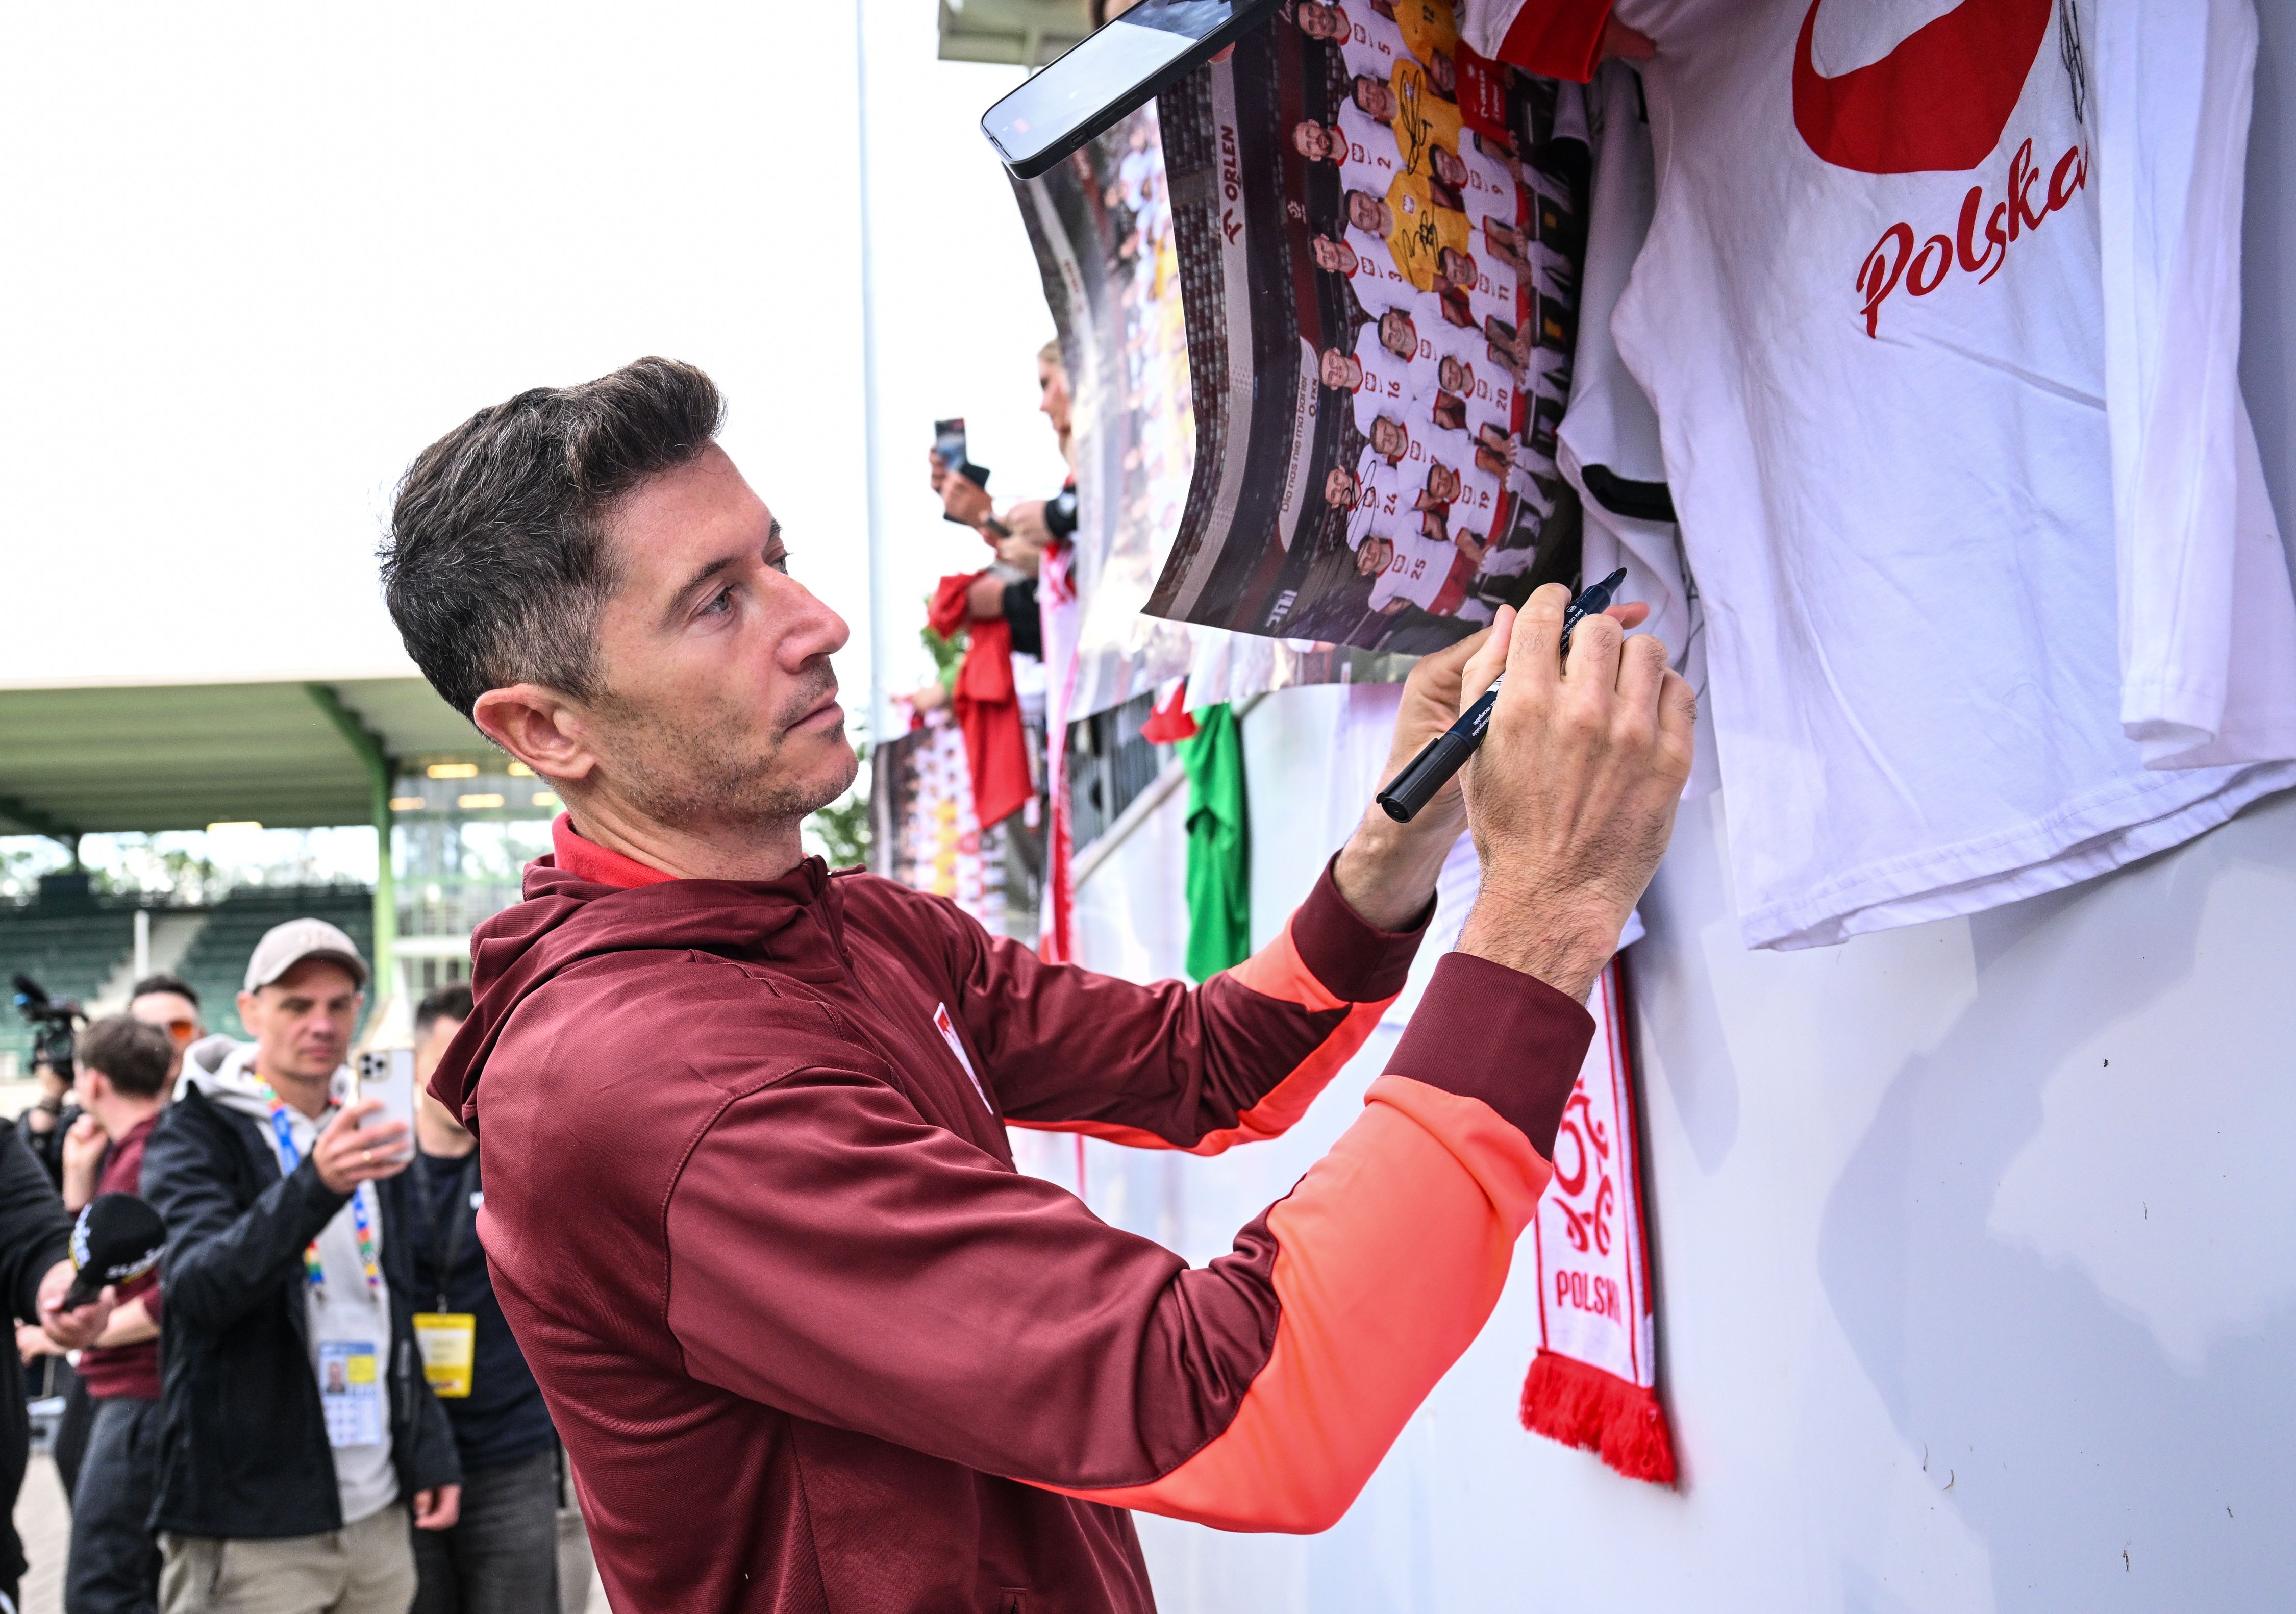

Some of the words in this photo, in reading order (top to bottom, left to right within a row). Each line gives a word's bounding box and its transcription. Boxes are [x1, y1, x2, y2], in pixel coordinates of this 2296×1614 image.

[1378, 41, 1391, 55] 5
[1220, 125, 1238, 202] ORLEN
[1378, 156, 1391, 169] 2
[1856, 137, 2088, 339] Polska
[1388, 270, 1402, 282] 3
[1499, 285, 1509, 300] 11
[1296, 375, 1308, 414] barier
[1387, 381, 1401, 399] 16
[1495, 388, 1508, 411] 20
[1296, 415, 1304, 439] ma
[1292, 440, 1301, 461] nie
[1286, 463, 1298, 489] nas
[1383, 492, 1399, 515] 24
[1478, 490, 1490, 509] 19
[1411, 557, 1427, 580] 25
[1575, 608, 1584, 617] para
[1471, 714, 1491, 737] echargeable
[1473, 706, 1491, 725] recargable
